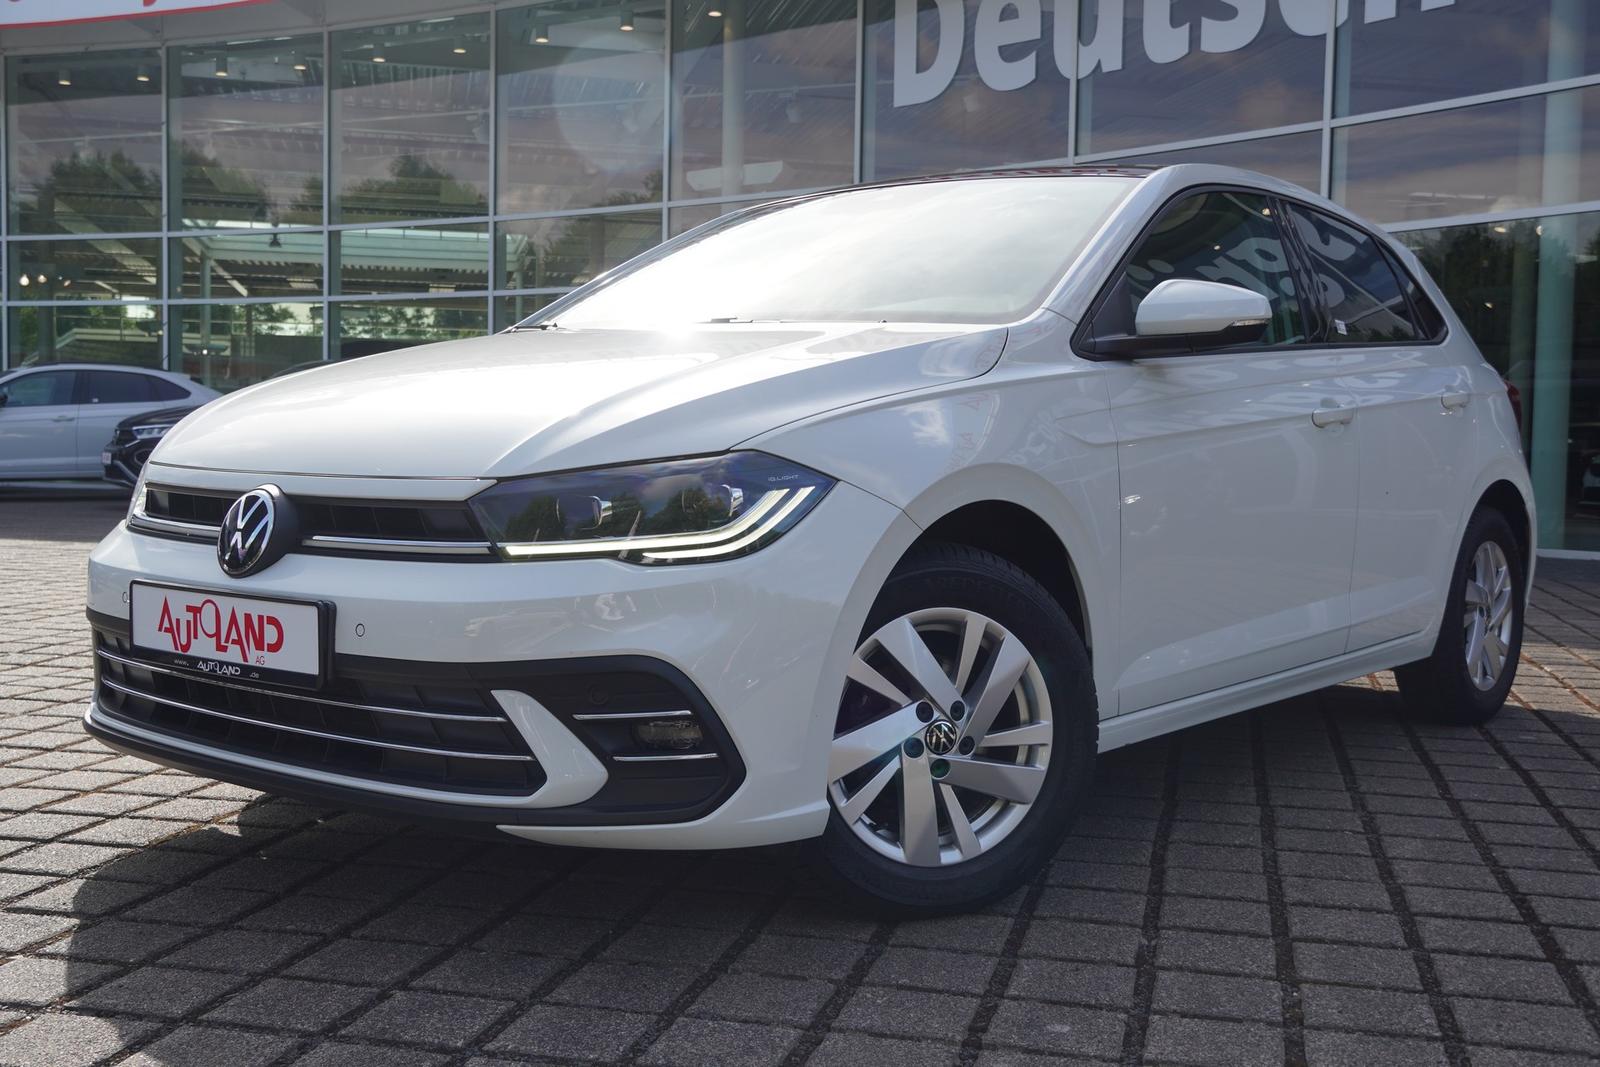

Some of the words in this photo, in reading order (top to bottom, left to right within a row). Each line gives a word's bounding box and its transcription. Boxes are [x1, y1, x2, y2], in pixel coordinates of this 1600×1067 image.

[893, 0, 1456, 108] Deuts
[157, 595, 285, 663] AUTOLAND
[197, 660, 241, 676] AUTOLAND
[255, 655, 266, 666] AG
